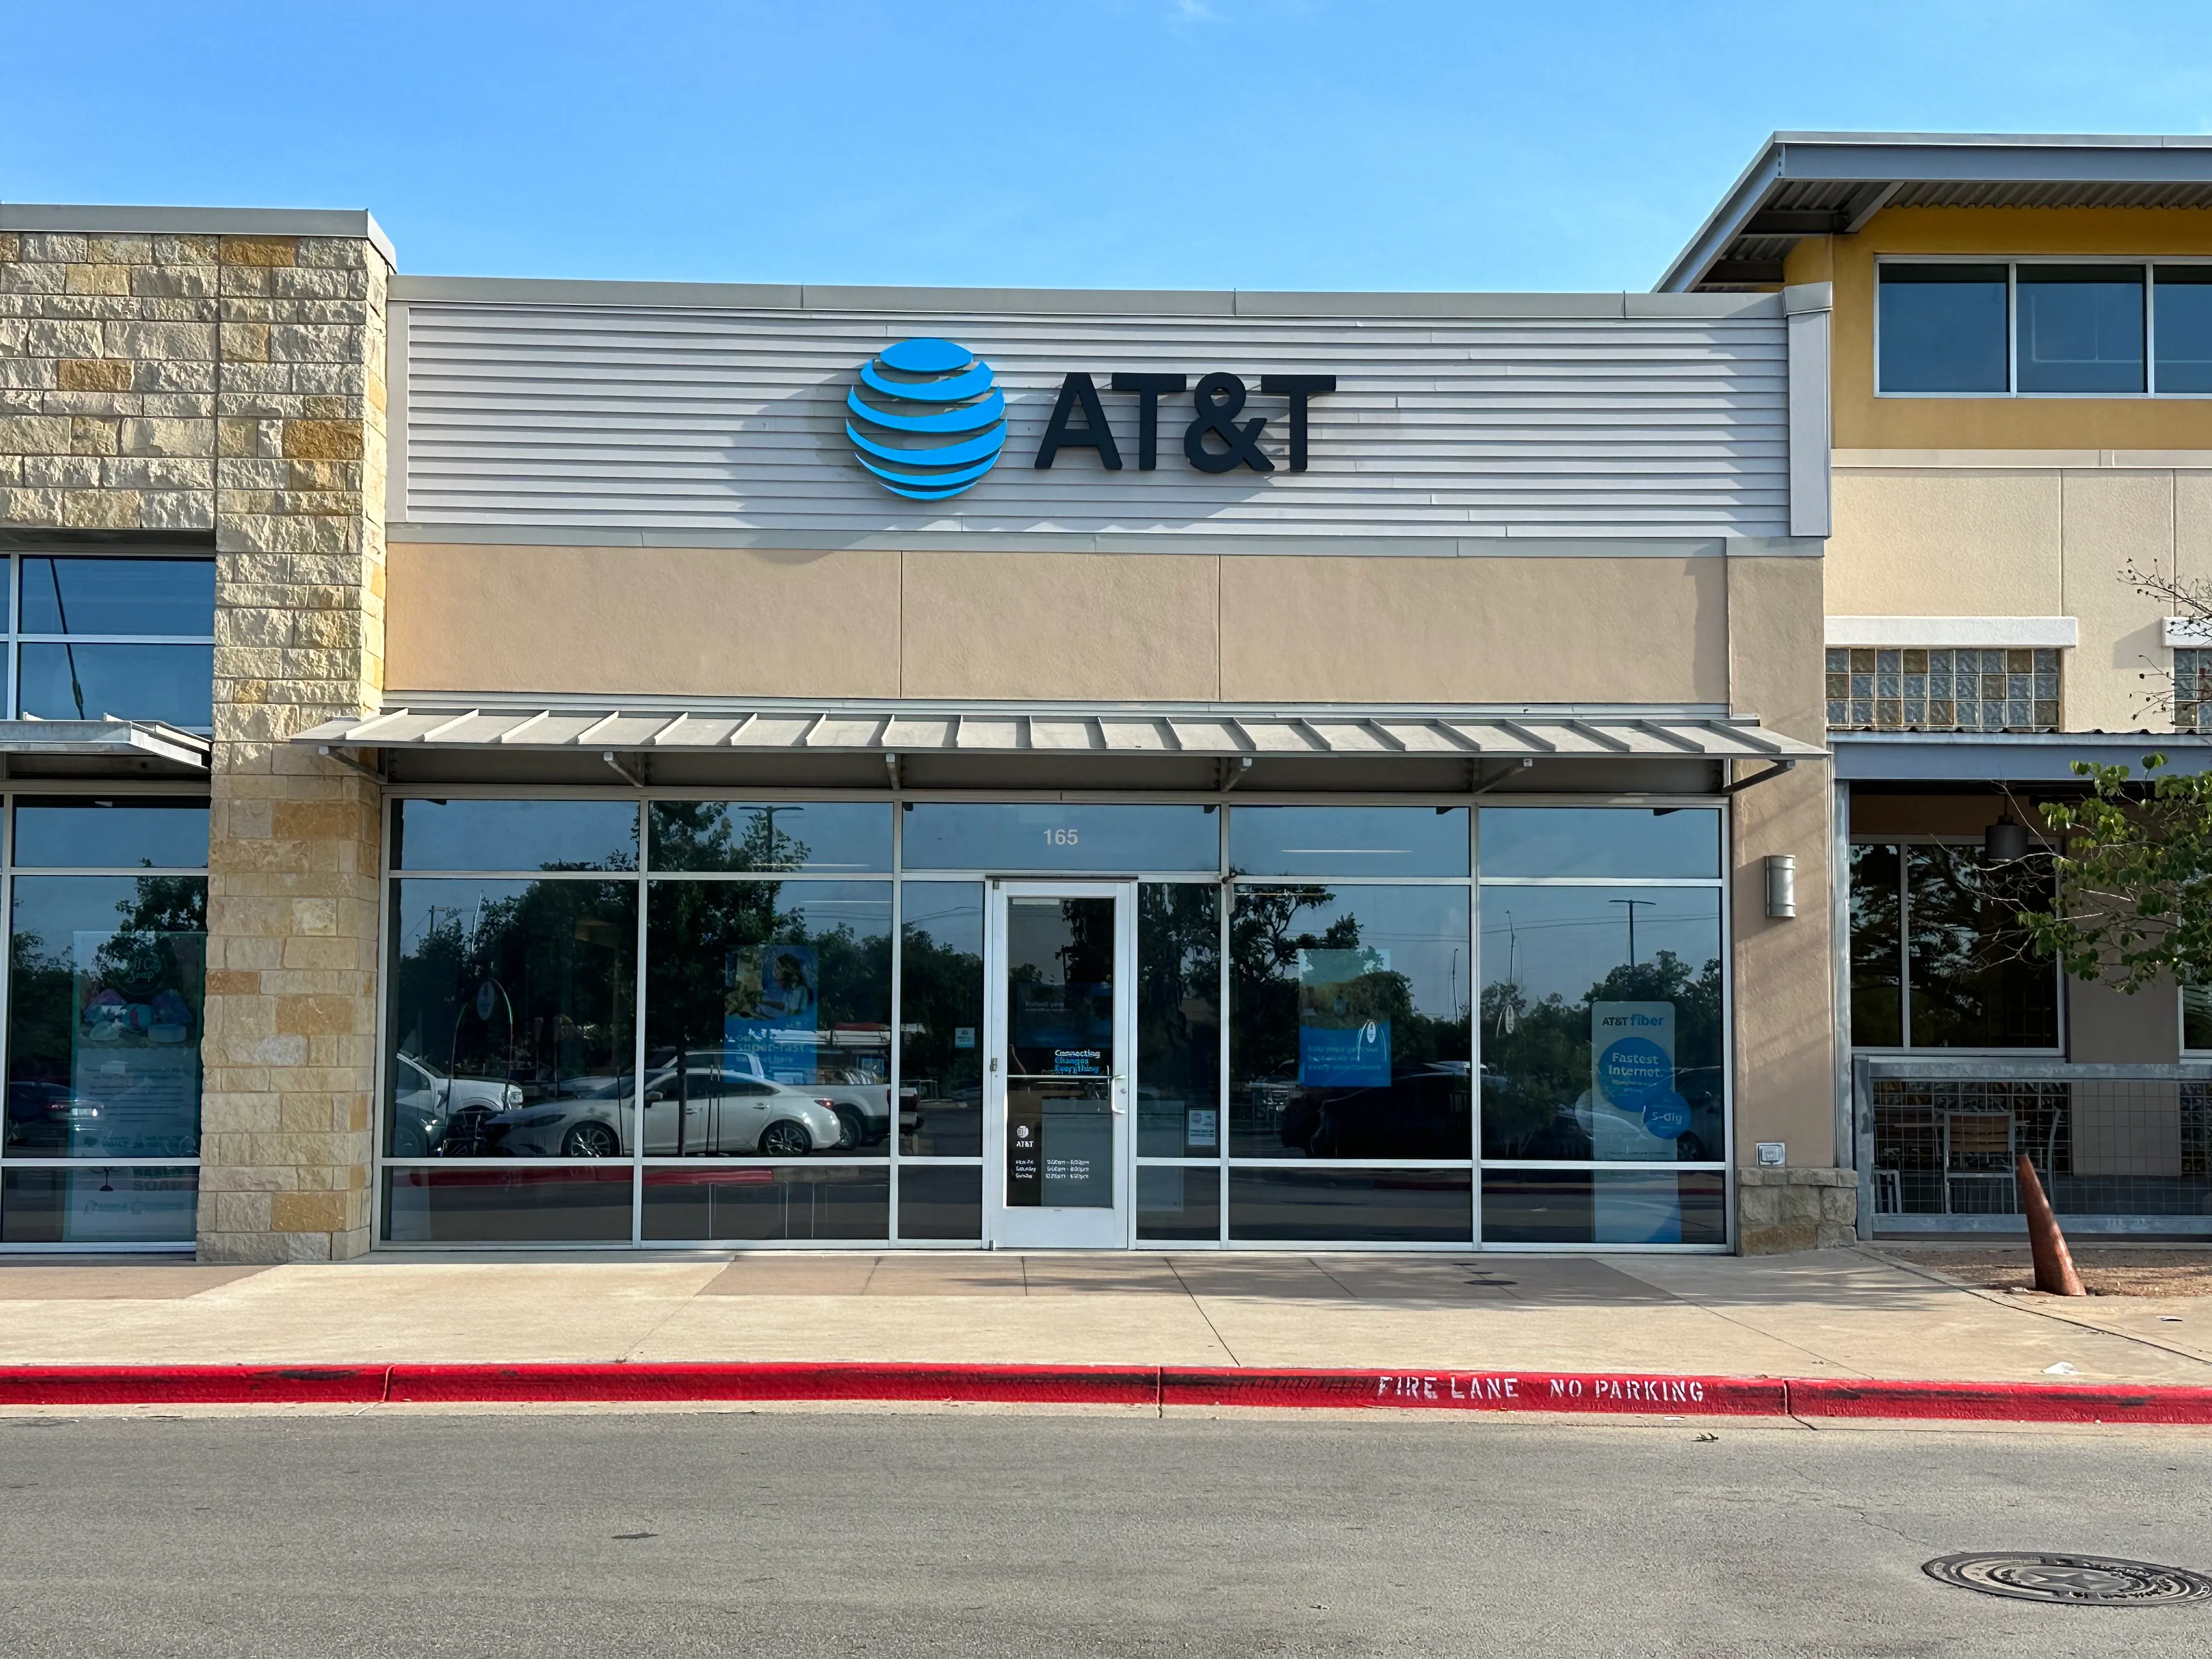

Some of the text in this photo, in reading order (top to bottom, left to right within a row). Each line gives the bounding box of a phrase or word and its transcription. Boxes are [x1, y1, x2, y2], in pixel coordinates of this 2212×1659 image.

[1034, 372, 1336, 473] AT&T
[1043, 829, 1078, 845] 165
[1602, 1014, 1664, 1026] AT&T fiber
[1055, 1049, 1101, 1059] Connecting
[1612, 1052, 1658, 1064] Fastest
[1378, 1376, 1703, 1402] FIRE LANE NO PARKING
